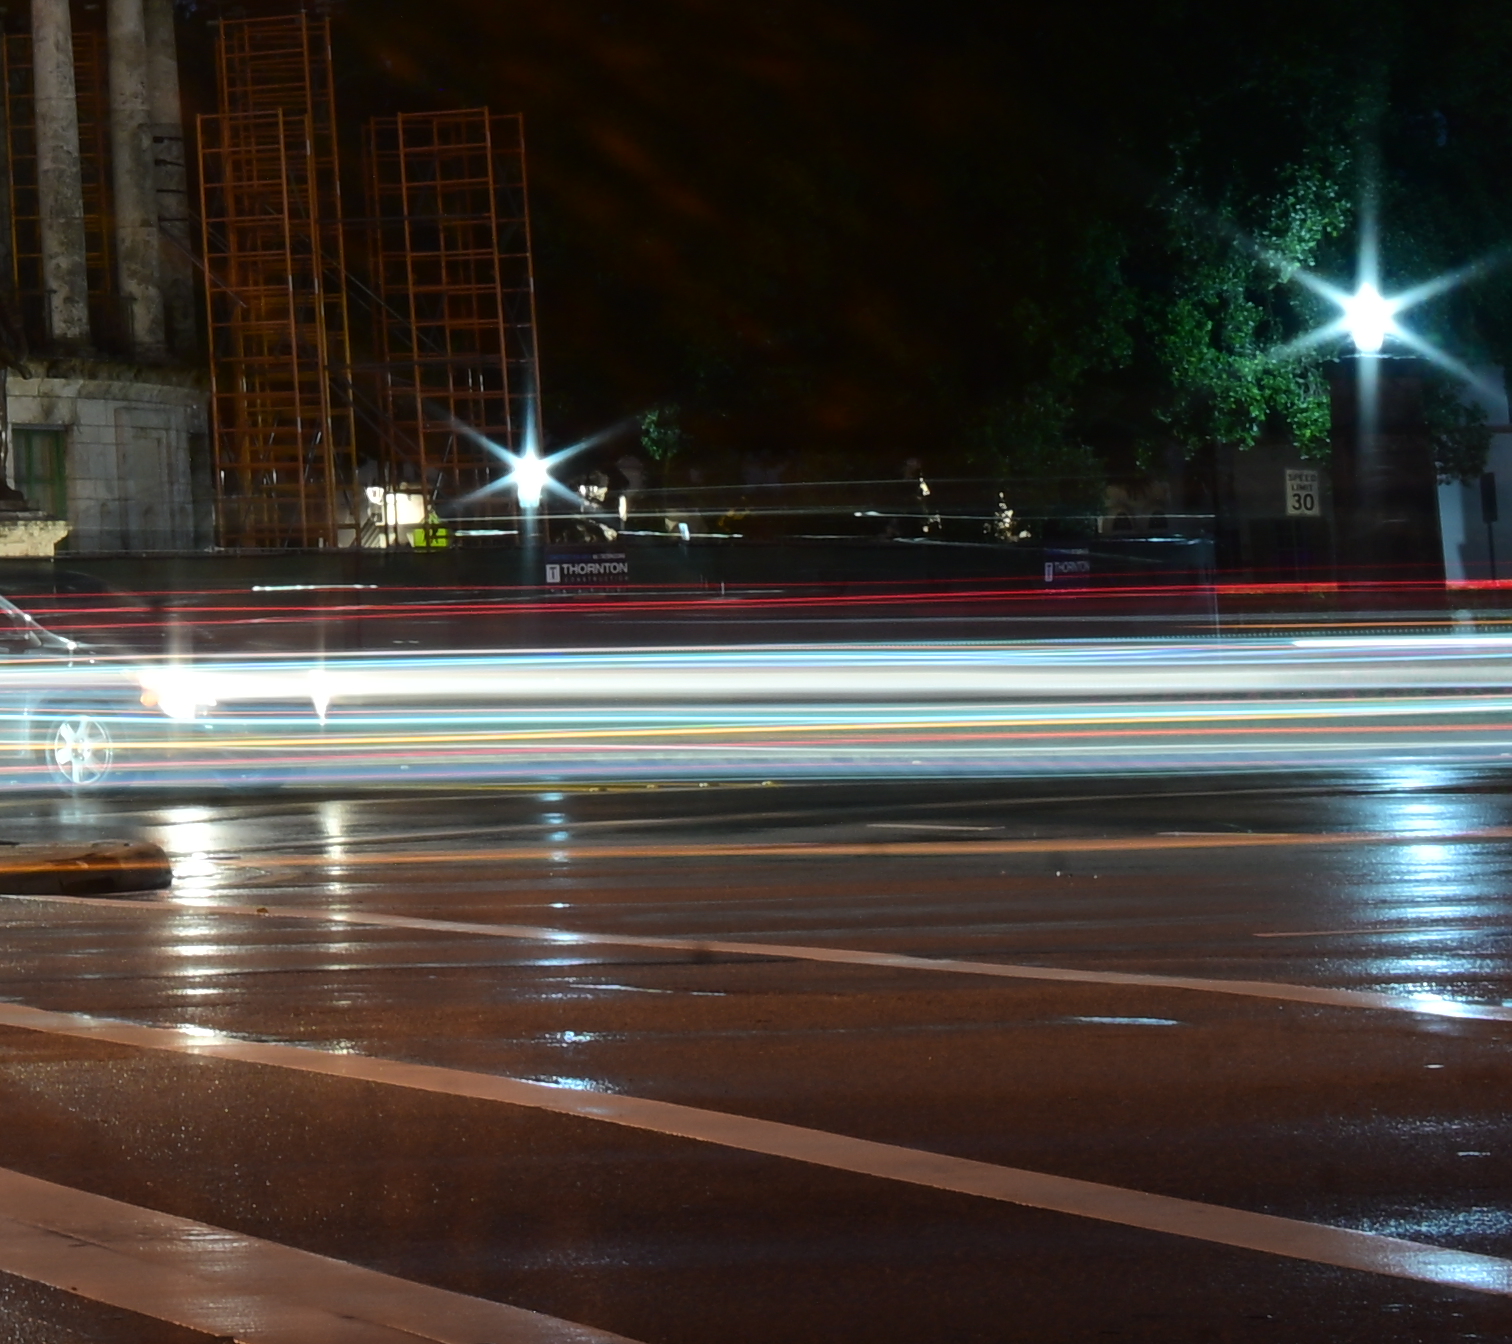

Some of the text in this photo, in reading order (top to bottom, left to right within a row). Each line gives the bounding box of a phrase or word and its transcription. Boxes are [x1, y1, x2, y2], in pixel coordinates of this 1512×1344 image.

[1291, 484, 1313, 492] LIMIT
[1292, 493, 1314, 511] 30
[561, 562, 629, 575] THORNTON
